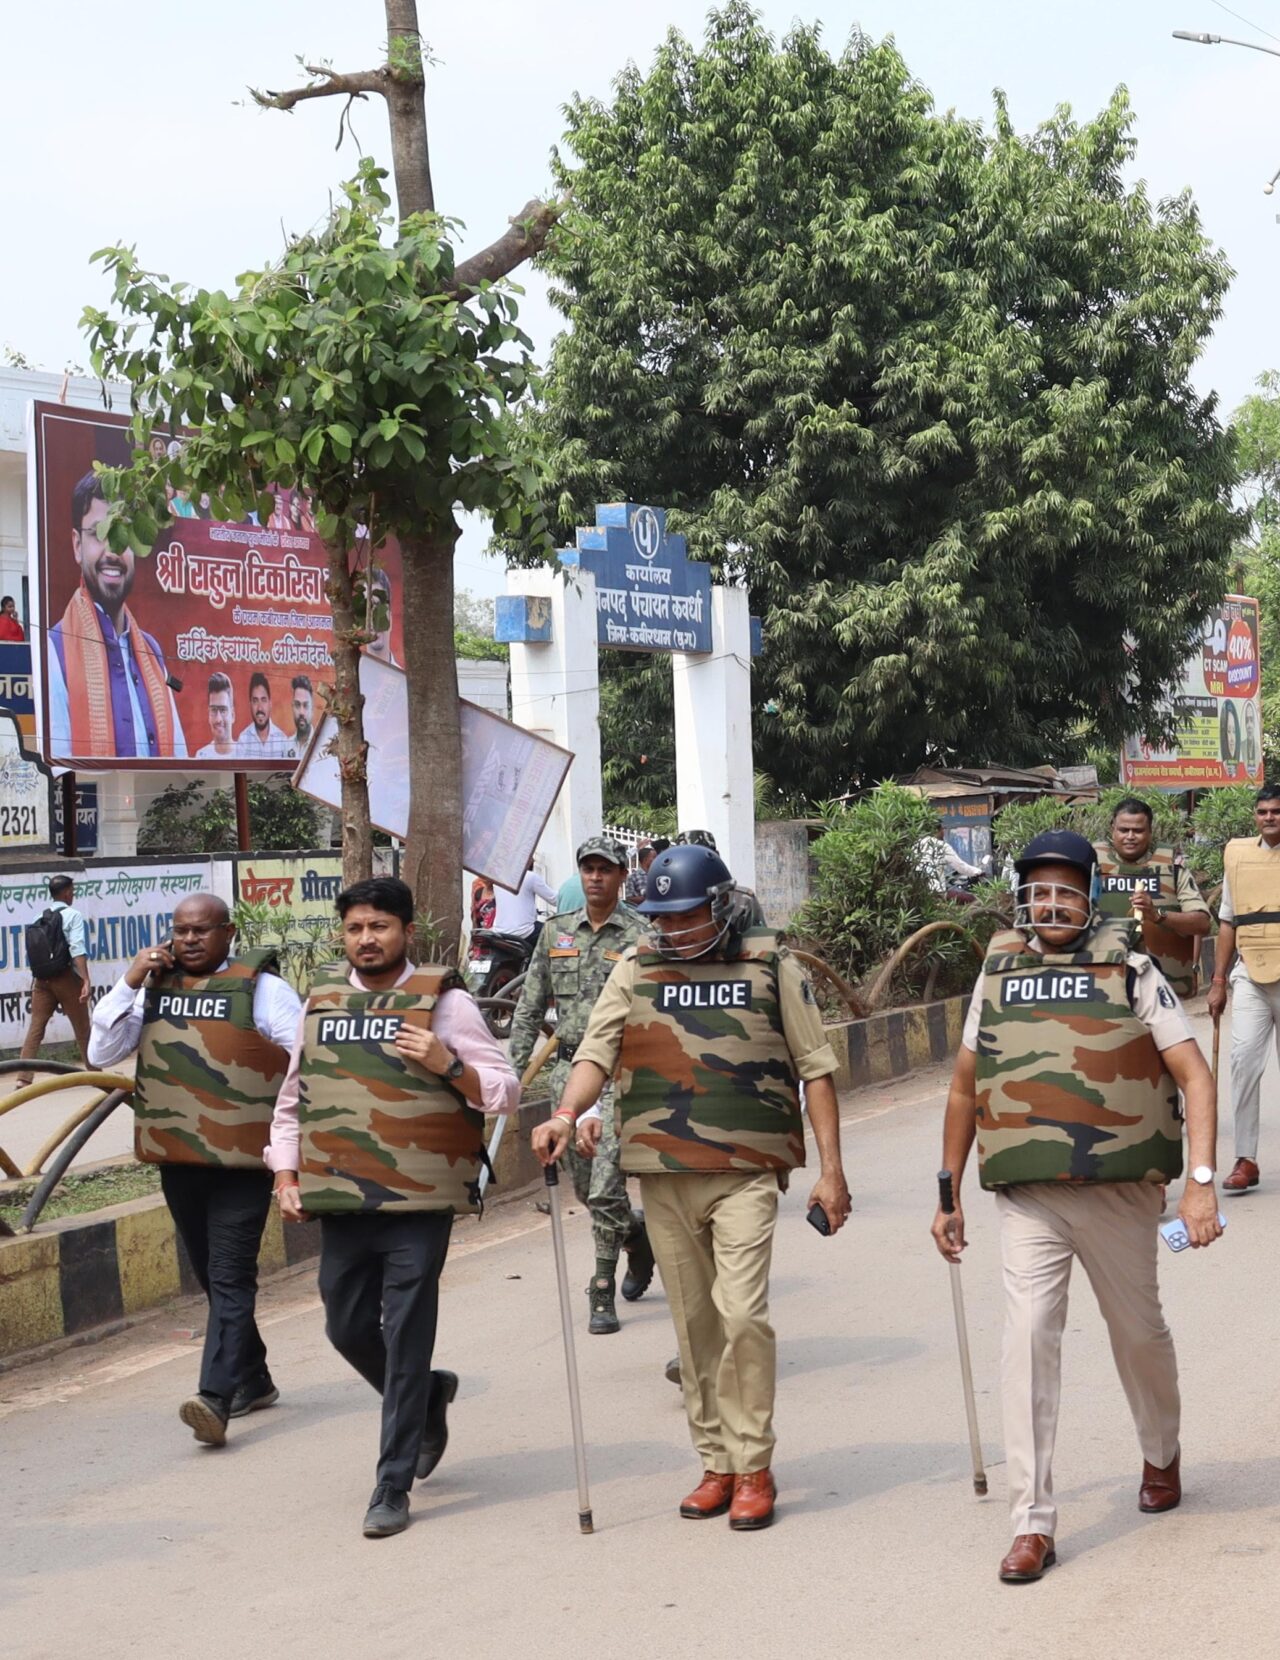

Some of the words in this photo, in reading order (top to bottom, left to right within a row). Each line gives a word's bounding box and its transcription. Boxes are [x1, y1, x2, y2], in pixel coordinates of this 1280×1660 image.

[156, 542, 186, 593] श्री
[187, 554, 243, 609] राहुल
[246, 550, 321, 605] टिकरिहा
[625, 560, 672, 585] कार्यालय
[630, 583, 670, 619] पंचायत
[232, 605, 241, 624] के
[176, 626, 218, 662] हार्दिक
[1229, 635, 1252, 660] 40%
[1212, 658, 1228, 673] SCAN
[1228, 665, 1253, 684] DISCOUNT
[1210, 681, 1224, 694] MRI
[1, 805, 38, 836] 2321
[84, 914, 151, 960] CATION
[663, 983, 746, 1007] POLICE
[1005, 976, 1089, 1002] POLICE
[158, 995, 227, 1018] POLICE
[322, 1017, 399, 1042] POLICE
